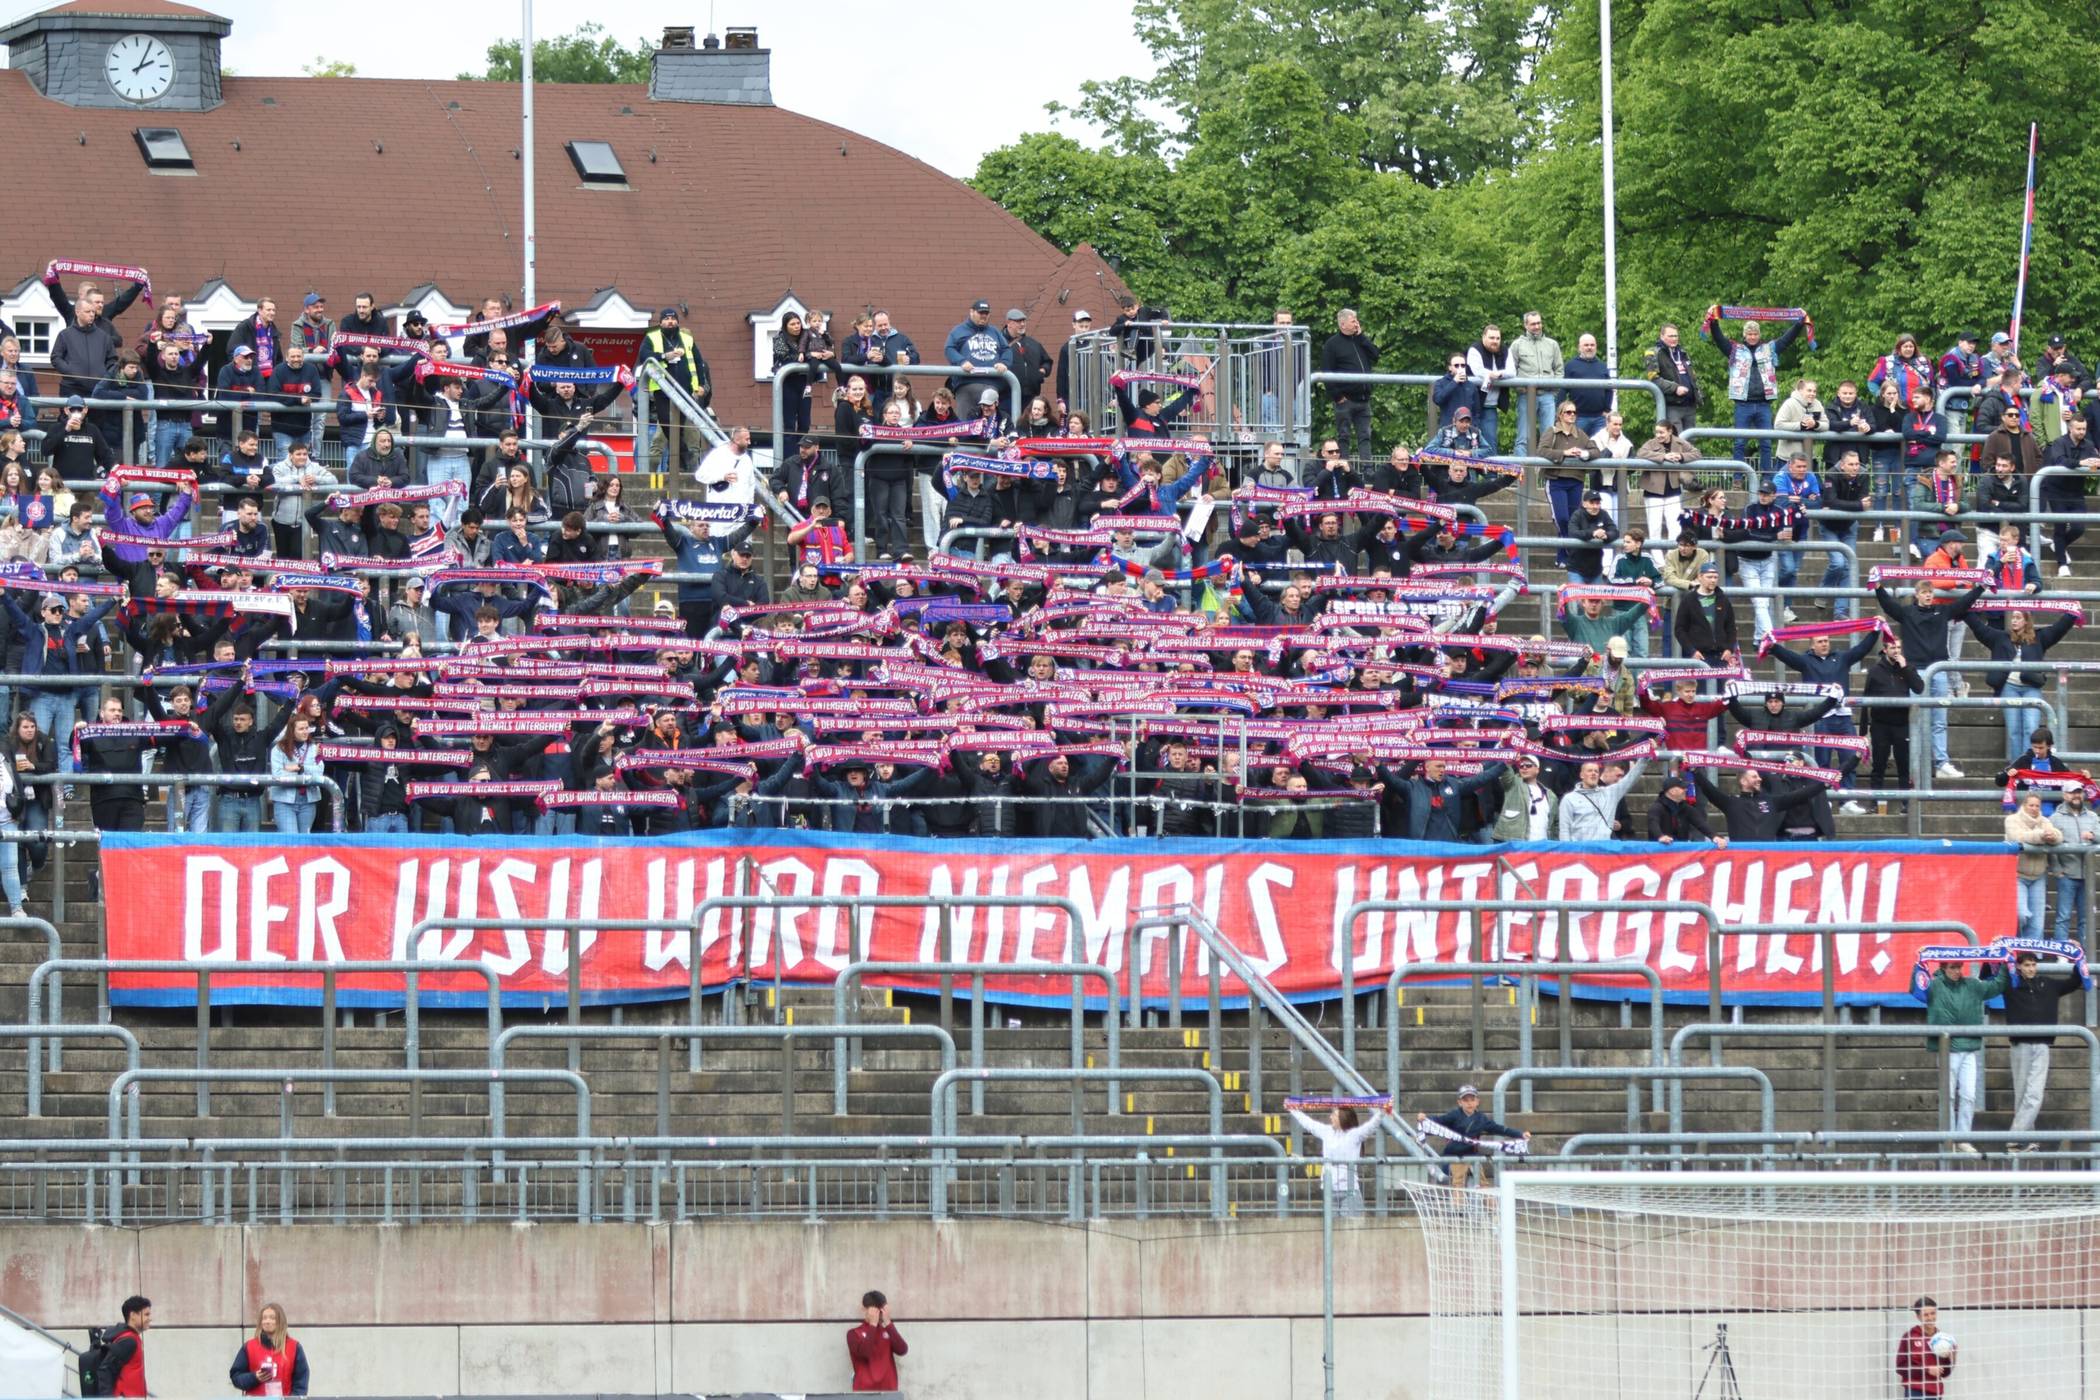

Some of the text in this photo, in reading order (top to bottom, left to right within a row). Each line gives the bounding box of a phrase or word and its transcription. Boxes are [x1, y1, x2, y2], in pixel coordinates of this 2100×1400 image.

[584, 336, 636, 345] Krakauer
[968, 340, 998, 352] VINTAGE
[533, 369, 612, 381] WUPPERTALER SV
[146, 470, 179, 479] WIEDER
[680, 501, 739, 520] Wuppertal
[1333, 602, 1385, 614] SPORT
[323, 748, 338, 758] DER
[339, 748, 358, 757] WSV
[360, 748, 381, 759] WIRD
[432, 784, 450, 794] WSV
[452, 783, 472, 794] WIRD
[557, 791, 632, 804] WSV WIRD NIEMALS
[184, 855, 1901, 980] DER WSV WIRD NIEMALS UNTERGEHEN!
